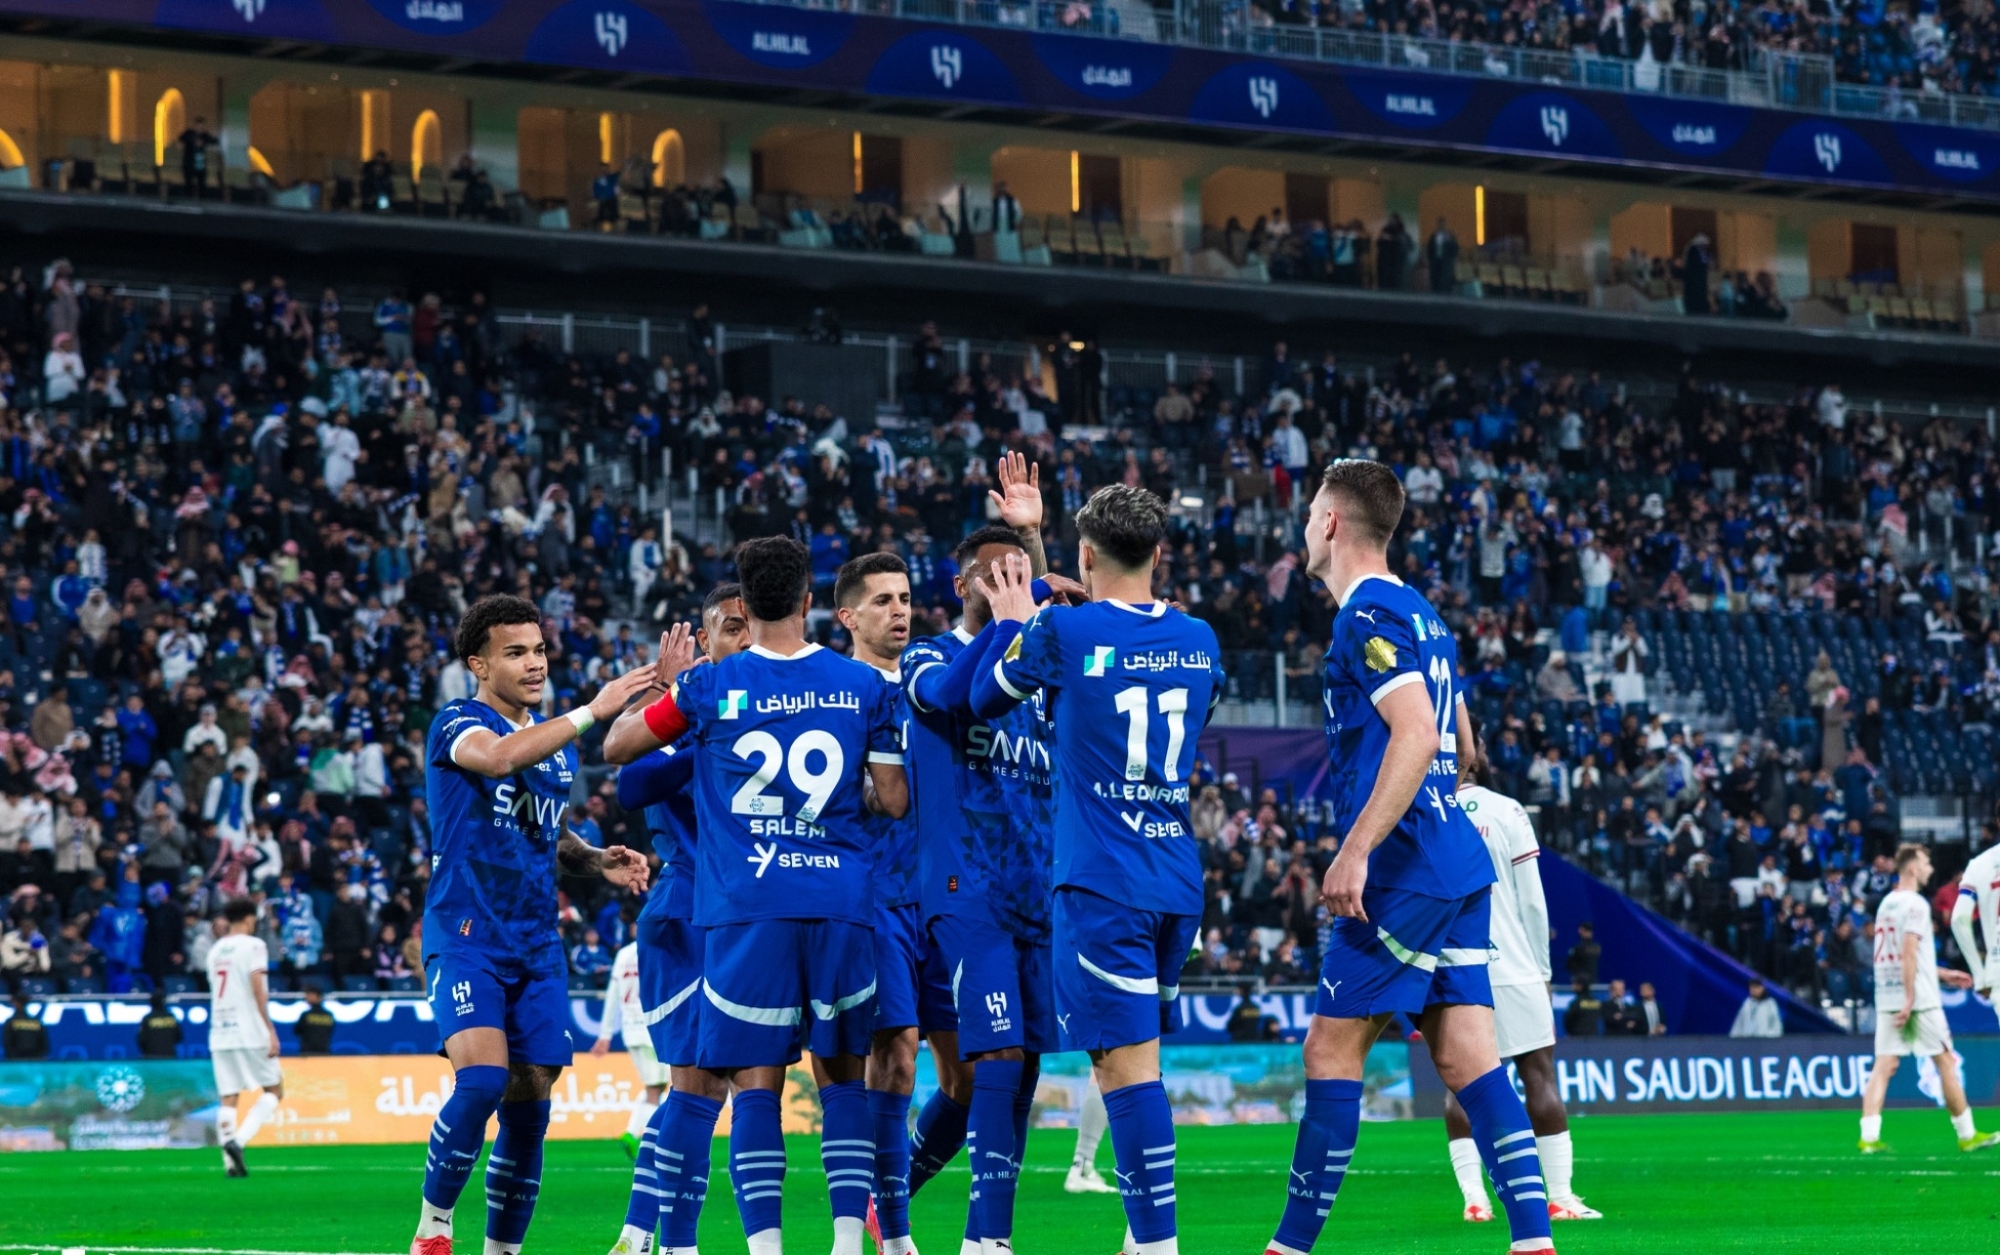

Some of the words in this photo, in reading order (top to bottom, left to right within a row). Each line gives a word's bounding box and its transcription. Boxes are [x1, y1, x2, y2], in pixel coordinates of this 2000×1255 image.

[1123, 651, 1178, 672] الرياض
[1181, 651, 1211, 673] بنك
[756, 691, 815, 714] الرياض
[818, 691, 860, 714] بنك
[1114, 686, 1189, 782] 11
[966, 725, 1050, 771] SAVVY
[731, 729, 844, 823] 29
[968, 761, 1019, 778] GAMES
[494, 818, 540, 839] GAMES
[750, 817, 826, 838] SALEM
[778, 853, 840, 868] SEVEN
[217, 970, 228, 998] 7
[1624, 1057, 1735, 1100] SAUDI
[1742, 1055, 1875, 1098] LEAGUE
